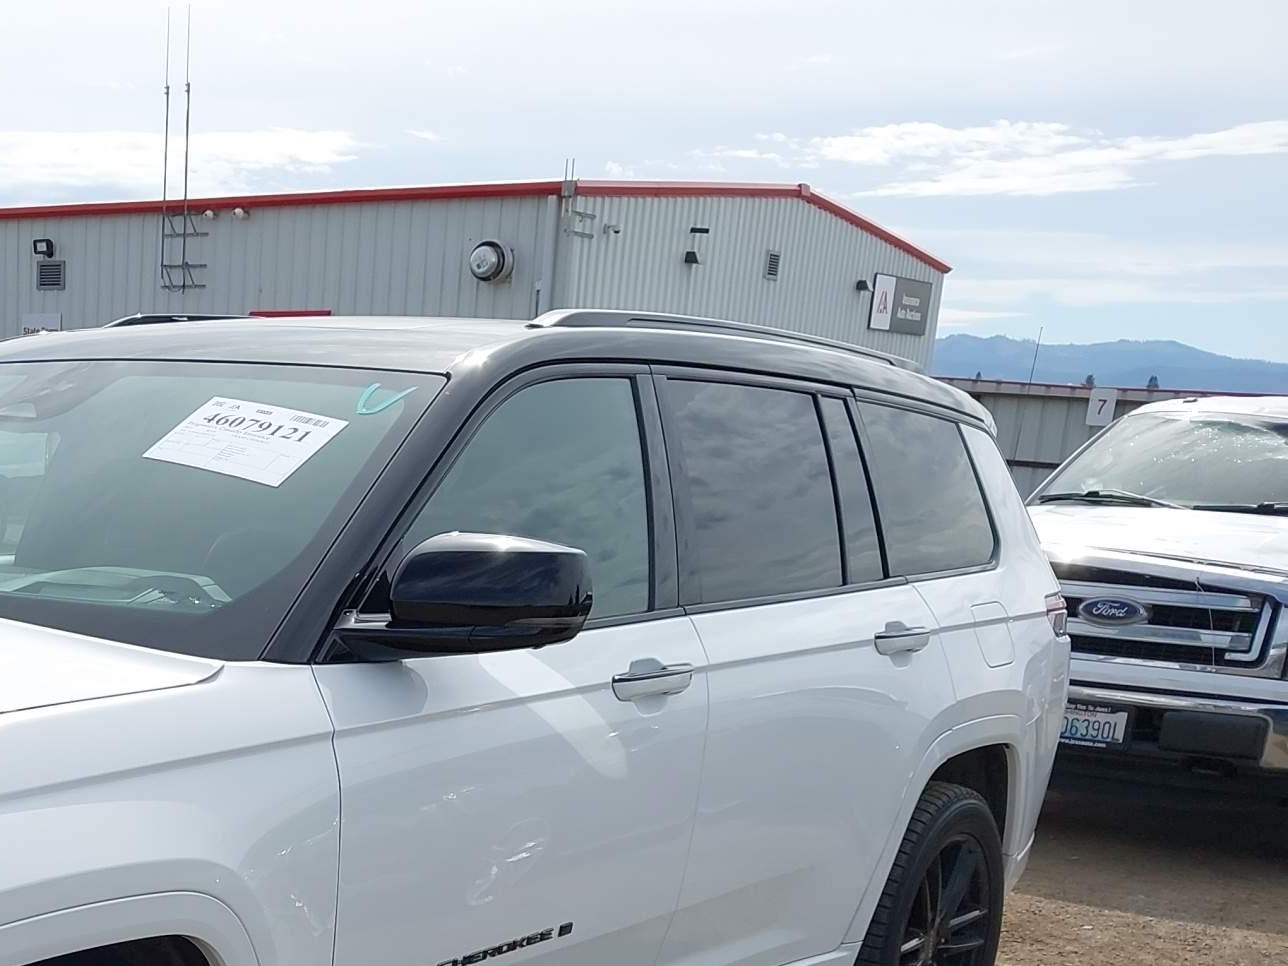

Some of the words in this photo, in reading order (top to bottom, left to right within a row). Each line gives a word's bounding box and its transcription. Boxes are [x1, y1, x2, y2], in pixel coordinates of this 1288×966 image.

[1098, 399, 1108, 416] 7
[203, 413, 312, 442] 46079121
[1092, 602, 1128, 617] Ford
